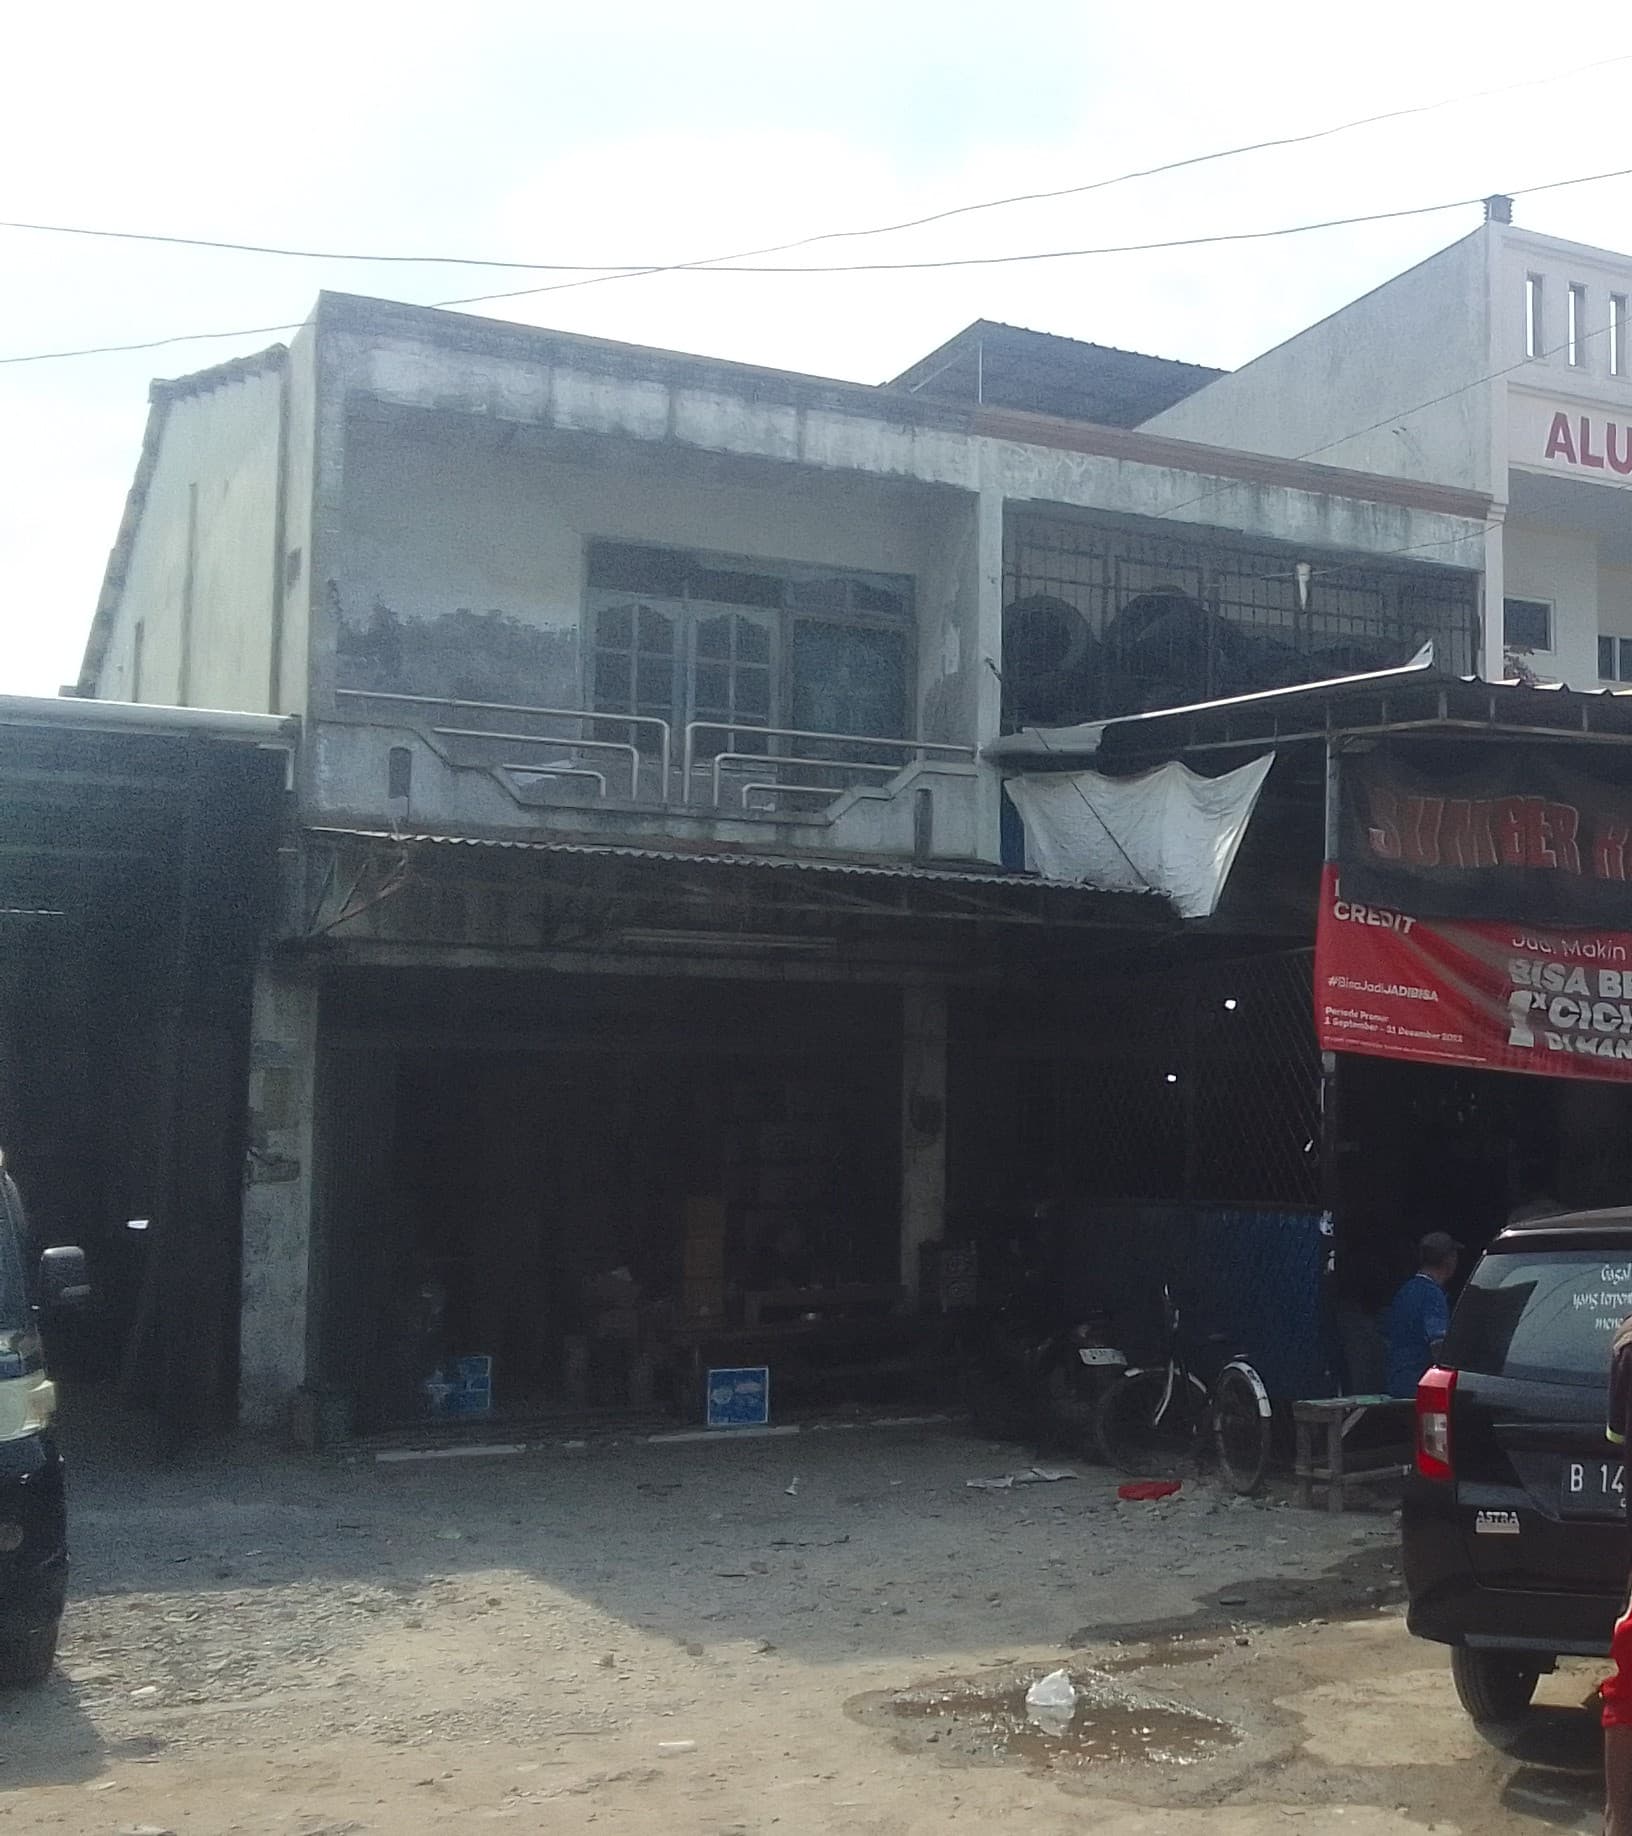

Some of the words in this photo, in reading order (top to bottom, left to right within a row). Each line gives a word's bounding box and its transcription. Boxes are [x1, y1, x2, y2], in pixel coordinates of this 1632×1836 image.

[1366, 794, 1582, 875] SUMBER
[1333, 901, 1416, 934] CREDIT
[1561, 939, 1626, 961] Makin
[1509, 957, 1591, 996] BISA
[1570, 1463, 1584, 1492] B
[1477, 1510, 1519, 1524] ASTRA
